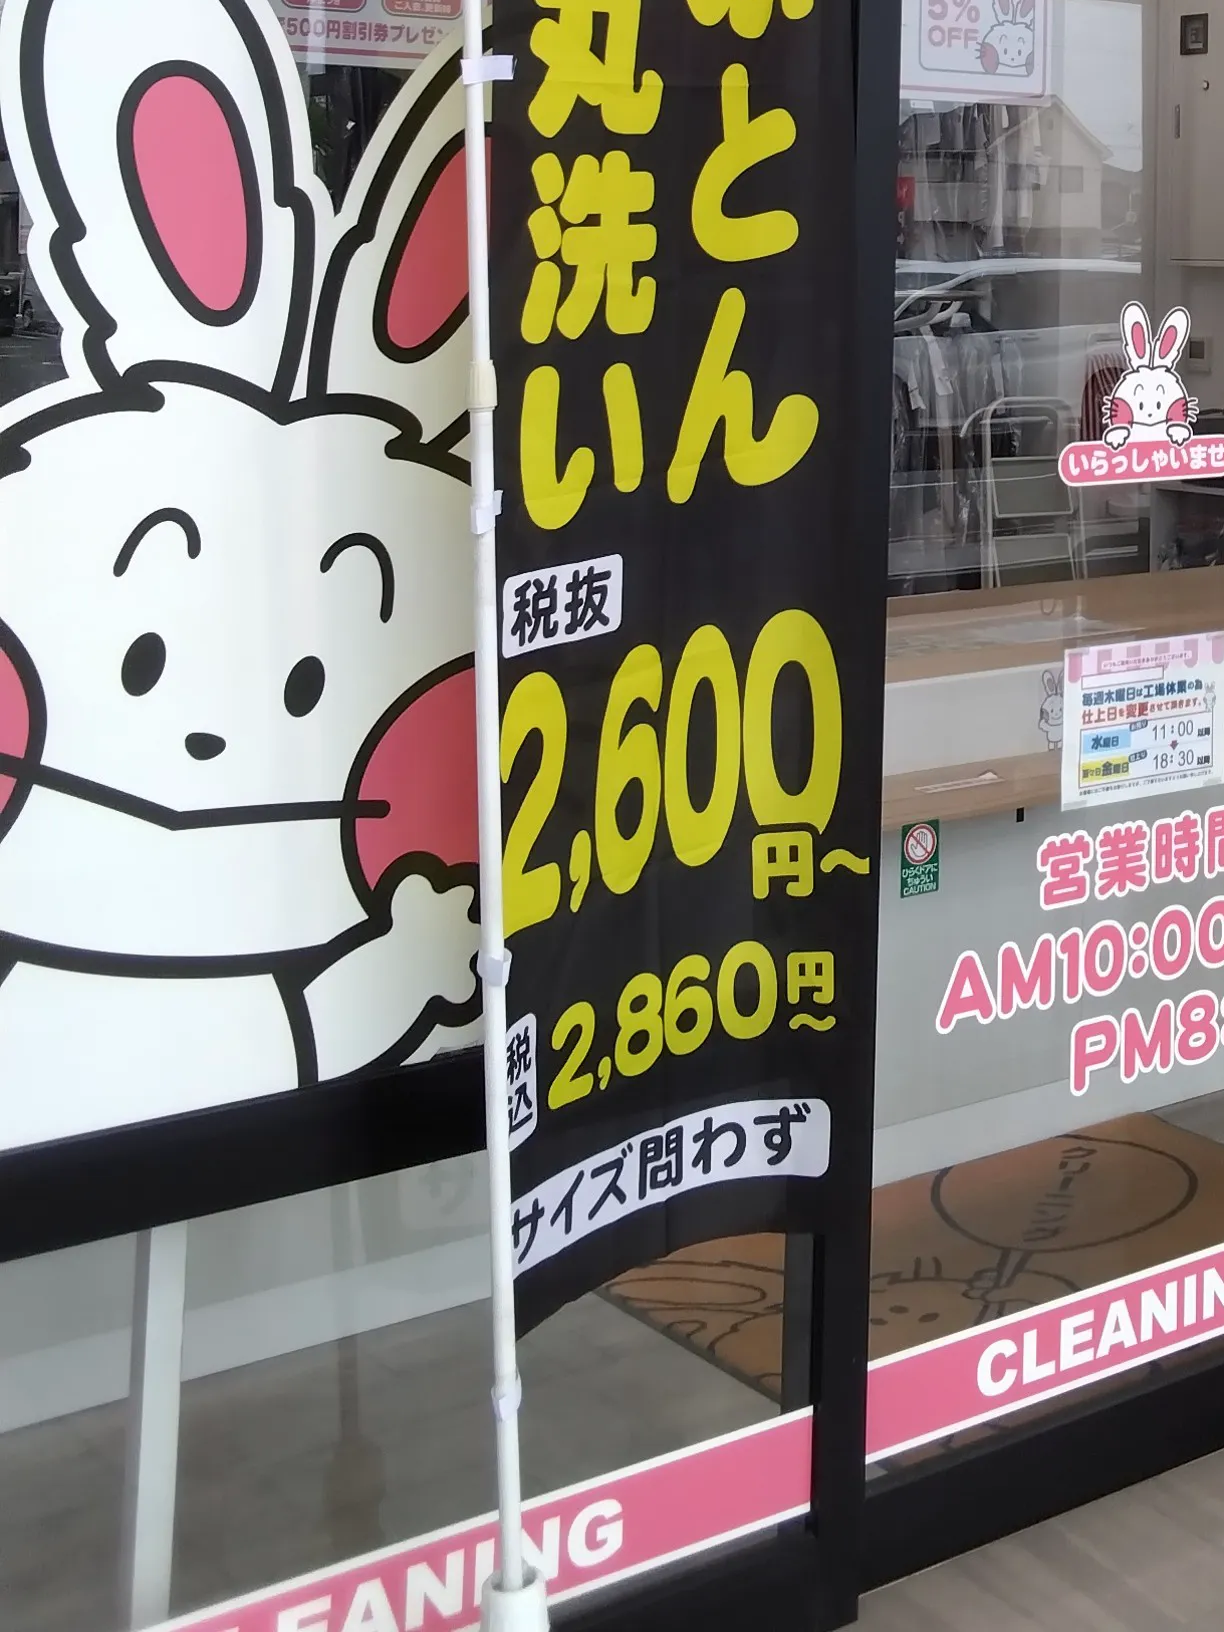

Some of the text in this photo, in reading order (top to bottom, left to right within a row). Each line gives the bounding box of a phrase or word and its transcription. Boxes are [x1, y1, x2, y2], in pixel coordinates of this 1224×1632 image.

[927, 26, 978, 49] OFF
[509, 568, 614, 648] 税抜
[903, 881, 937, 896] CAUTION
[511, 1101, 811, 1264] サイズ問わず
[218, 1497, 625, 1632] EANING
